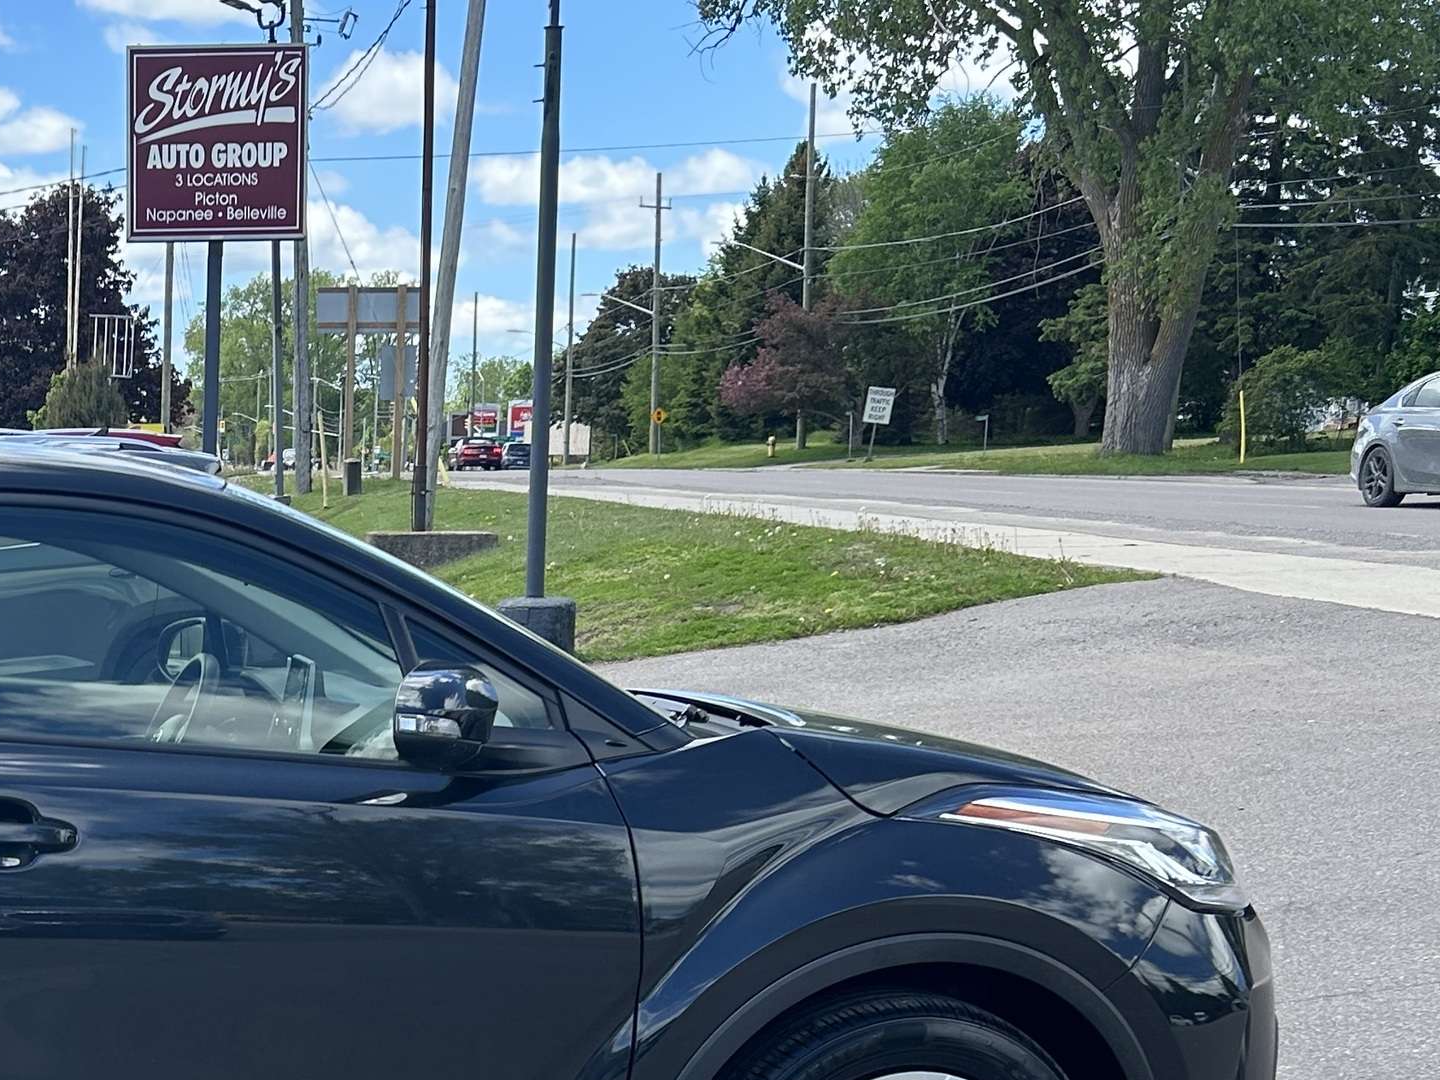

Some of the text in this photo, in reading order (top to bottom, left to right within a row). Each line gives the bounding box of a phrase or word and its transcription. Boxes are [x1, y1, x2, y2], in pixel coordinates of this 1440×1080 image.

[134, 50, 301, 134] Stormy's
[146, 142, 288, 170] AUTO GROUP
[175, 172, 258, 187] 3 LOCATIONS
[195, 192, 238, 206] Picton
[146, 206, 287, 223] Napanee Belleville
